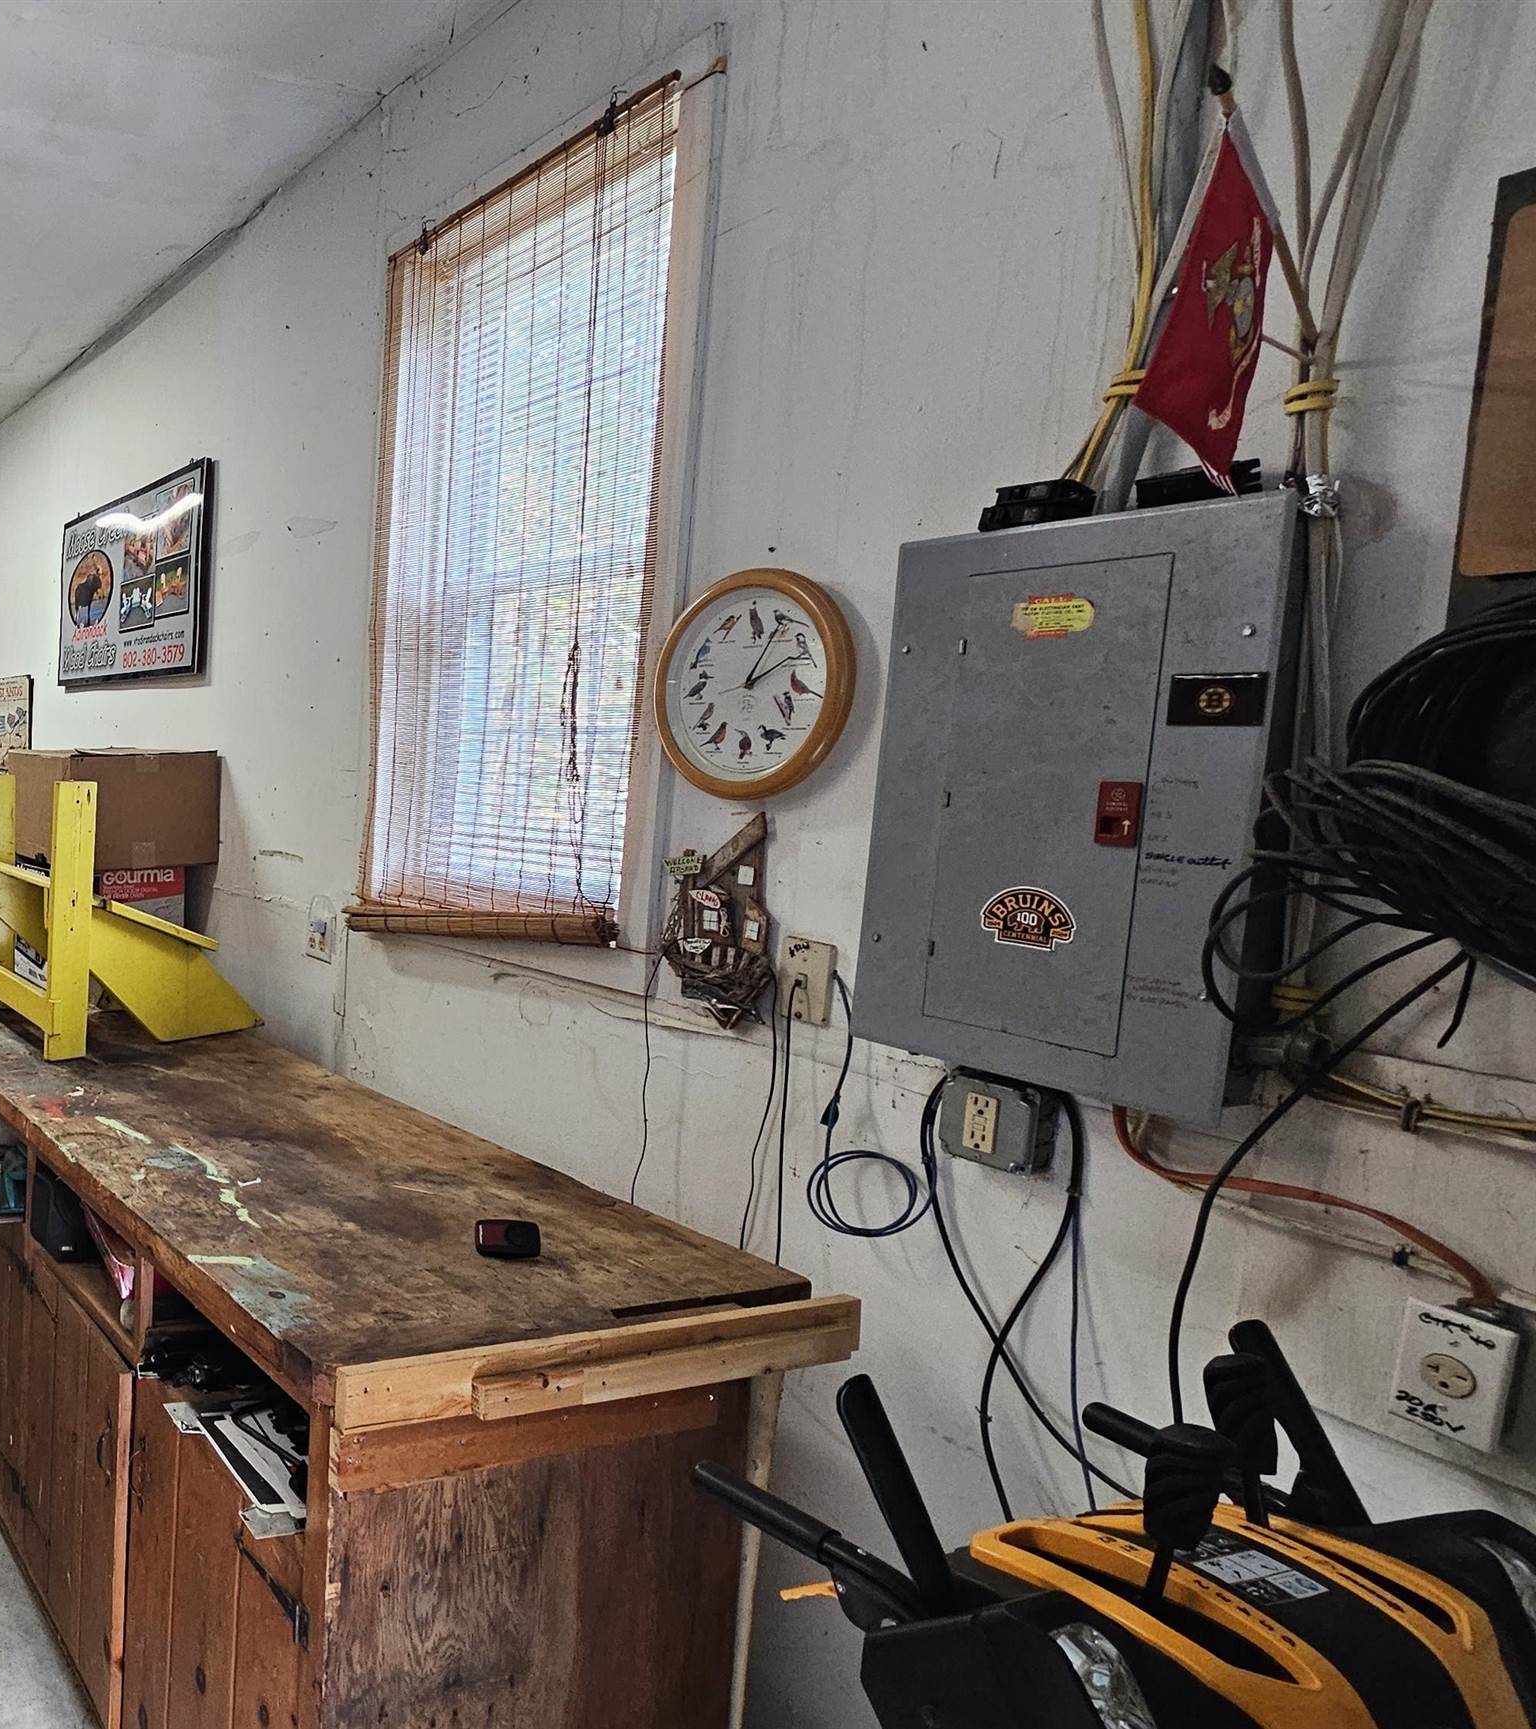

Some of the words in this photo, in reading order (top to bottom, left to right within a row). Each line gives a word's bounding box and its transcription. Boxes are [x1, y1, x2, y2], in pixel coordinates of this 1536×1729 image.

[123, 644, 184, 669] 802-380-3579
[992, 894, 1065, 926] BRUINS
[1017, 912, 1037, 925] 100
[1003, 930, 1048, 943] CENTENNIAL
